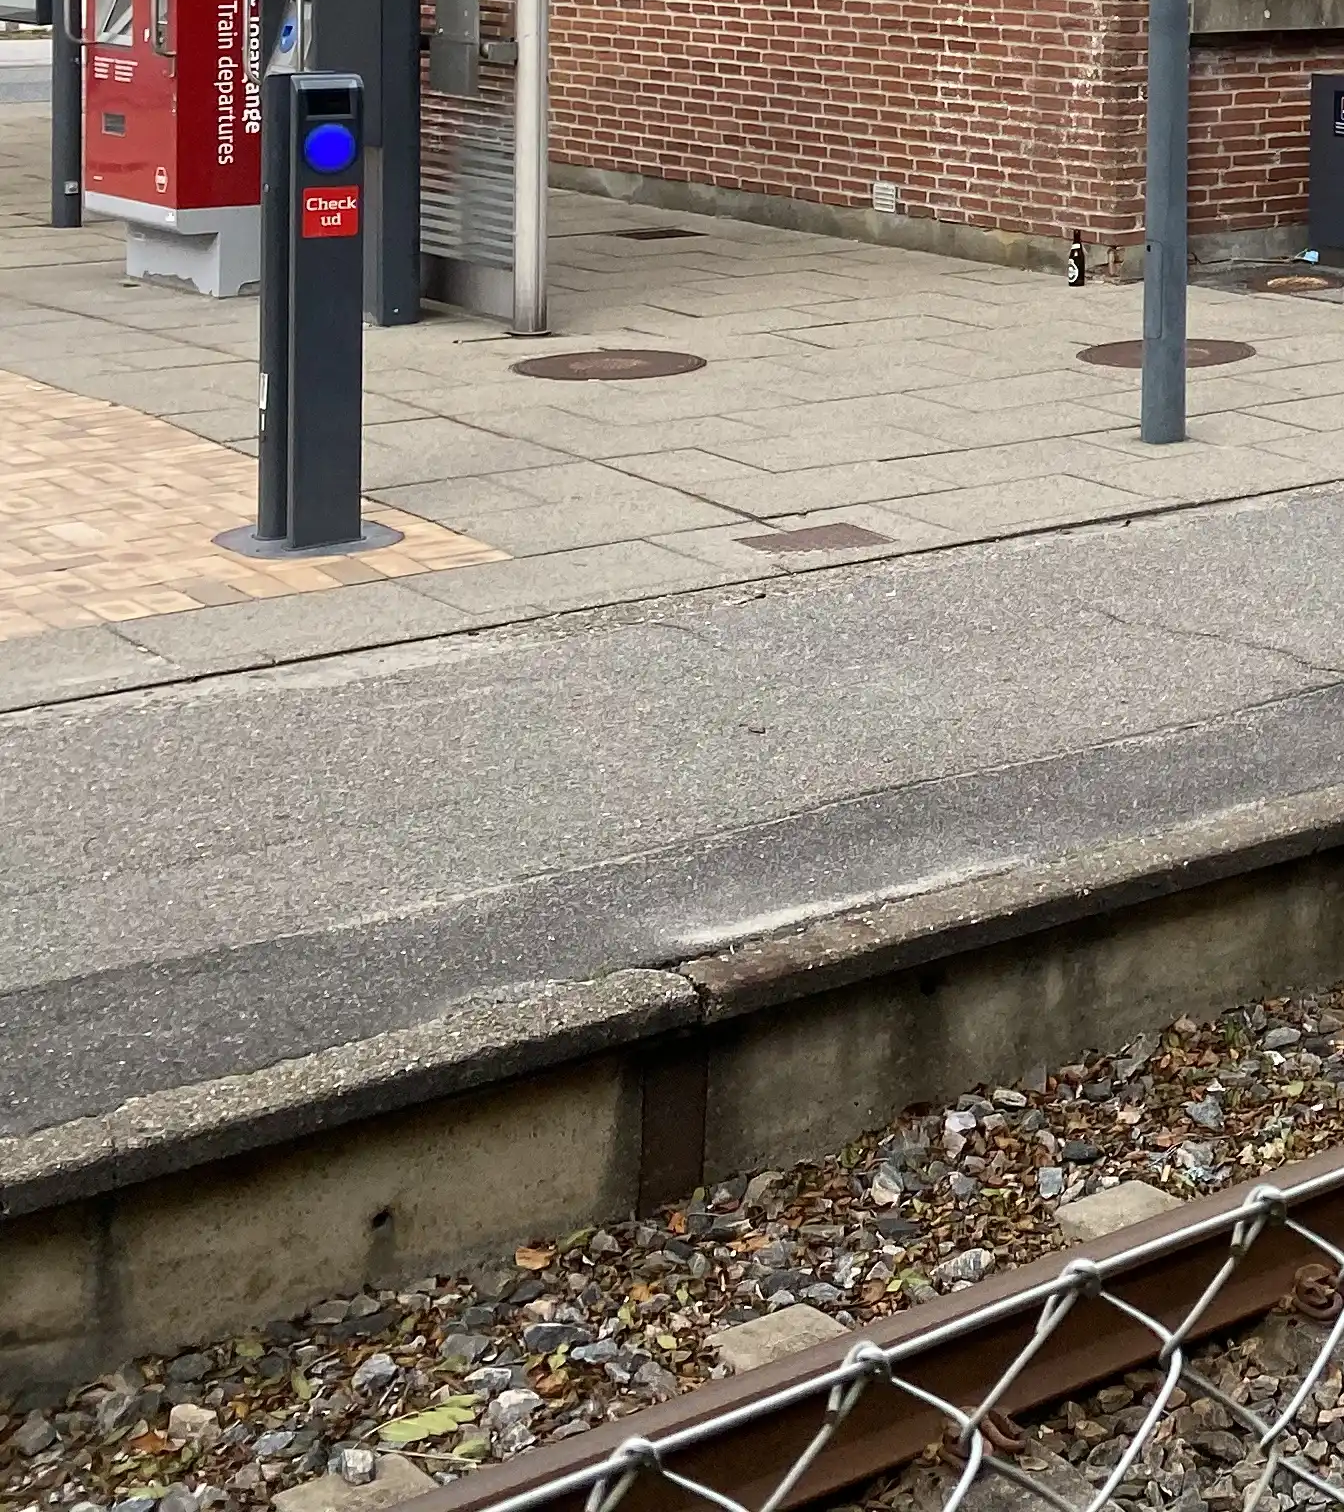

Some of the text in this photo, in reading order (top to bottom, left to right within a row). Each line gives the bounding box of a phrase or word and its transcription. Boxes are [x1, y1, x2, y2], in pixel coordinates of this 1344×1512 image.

[217, 0, 239, 50] Train
[213, 55, 239, 165] departures
[305, 196, 357, 212] Check
[320, 212, 342, 227] ud
